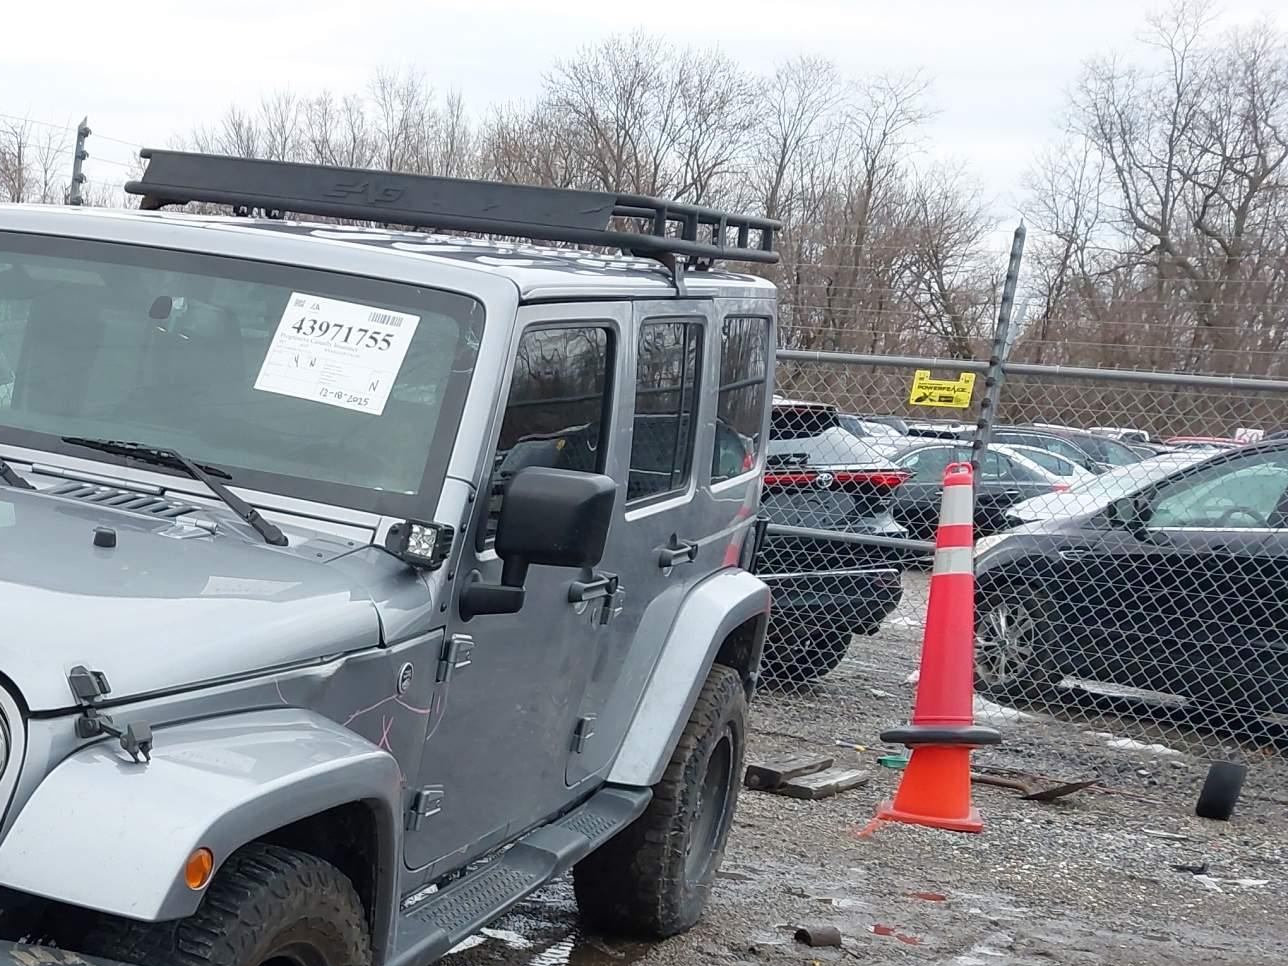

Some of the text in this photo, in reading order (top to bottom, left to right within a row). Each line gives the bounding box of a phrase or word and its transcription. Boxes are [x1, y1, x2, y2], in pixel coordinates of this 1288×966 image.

[292, 316, 394, 352] 43971755
[368, 379, 380, 392] N
[319, 386, 370, 407] 12-18-2025
